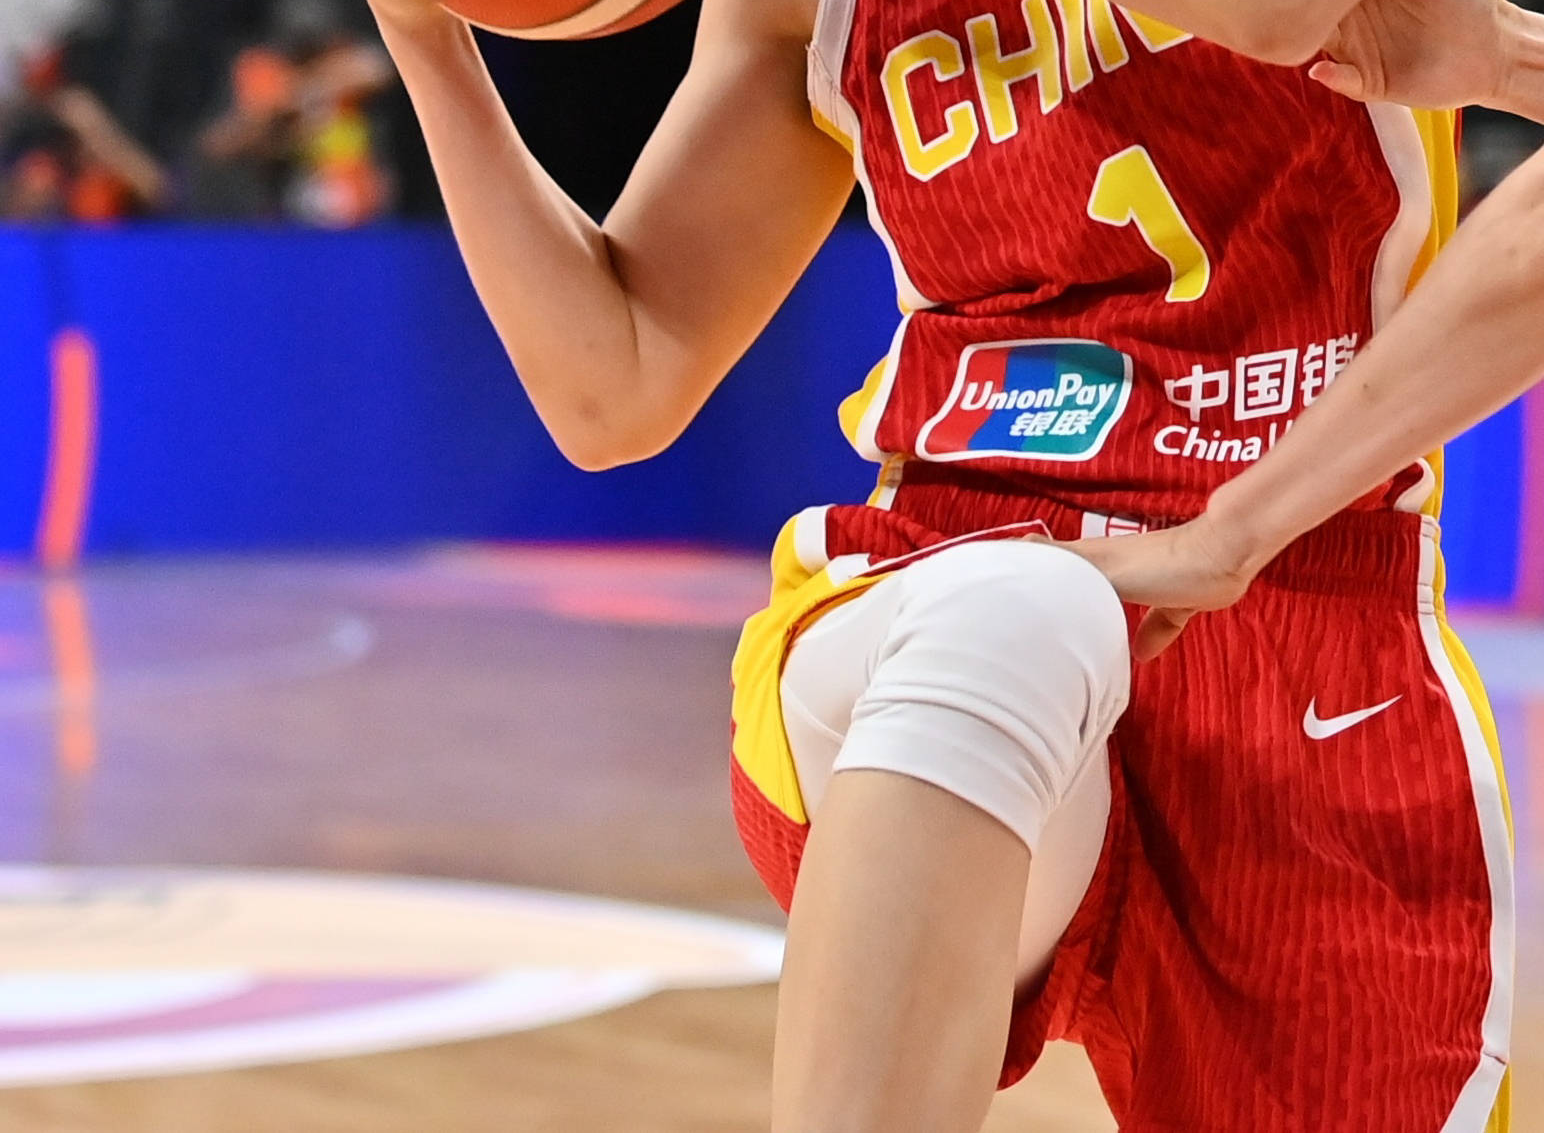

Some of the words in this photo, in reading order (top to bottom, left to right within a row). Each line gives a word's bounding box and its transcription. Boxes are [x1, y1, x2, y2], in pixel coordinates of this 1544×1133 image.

[1087, 145, 1210, 303] 1
[960, 373, 1117, 416] UnionPay
[1164, 332, 1358, 422] 中国银
[1009, 408, 1097, 437] 银联
[1153, 425, 1262, 462] China
